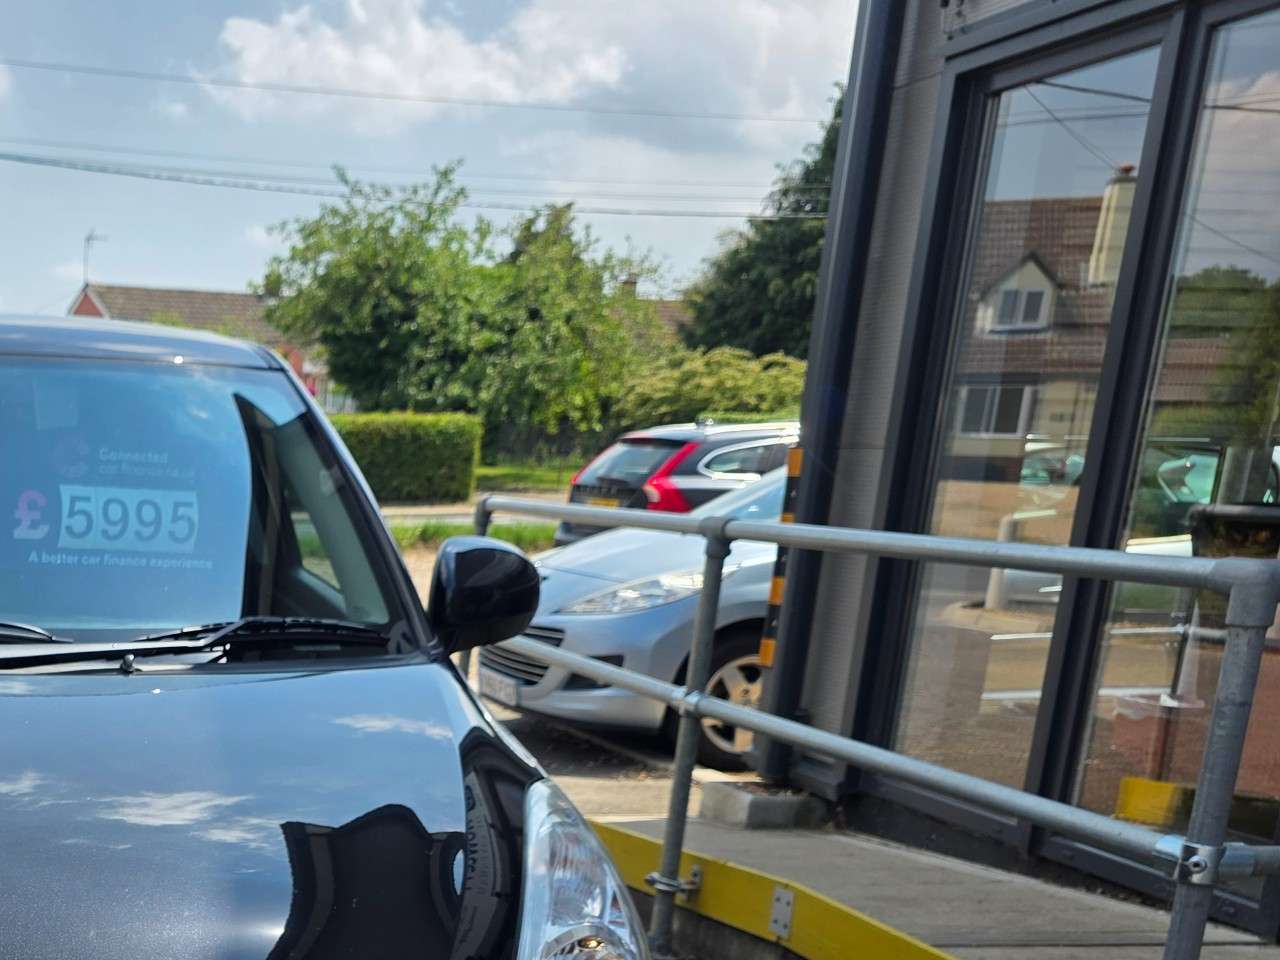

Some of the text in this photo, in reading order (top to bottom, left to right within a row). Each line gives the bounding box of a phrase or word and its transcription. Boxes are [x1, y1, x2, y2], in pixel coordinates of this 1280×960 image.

[28, 550, 214, 570] A better car finance experience
